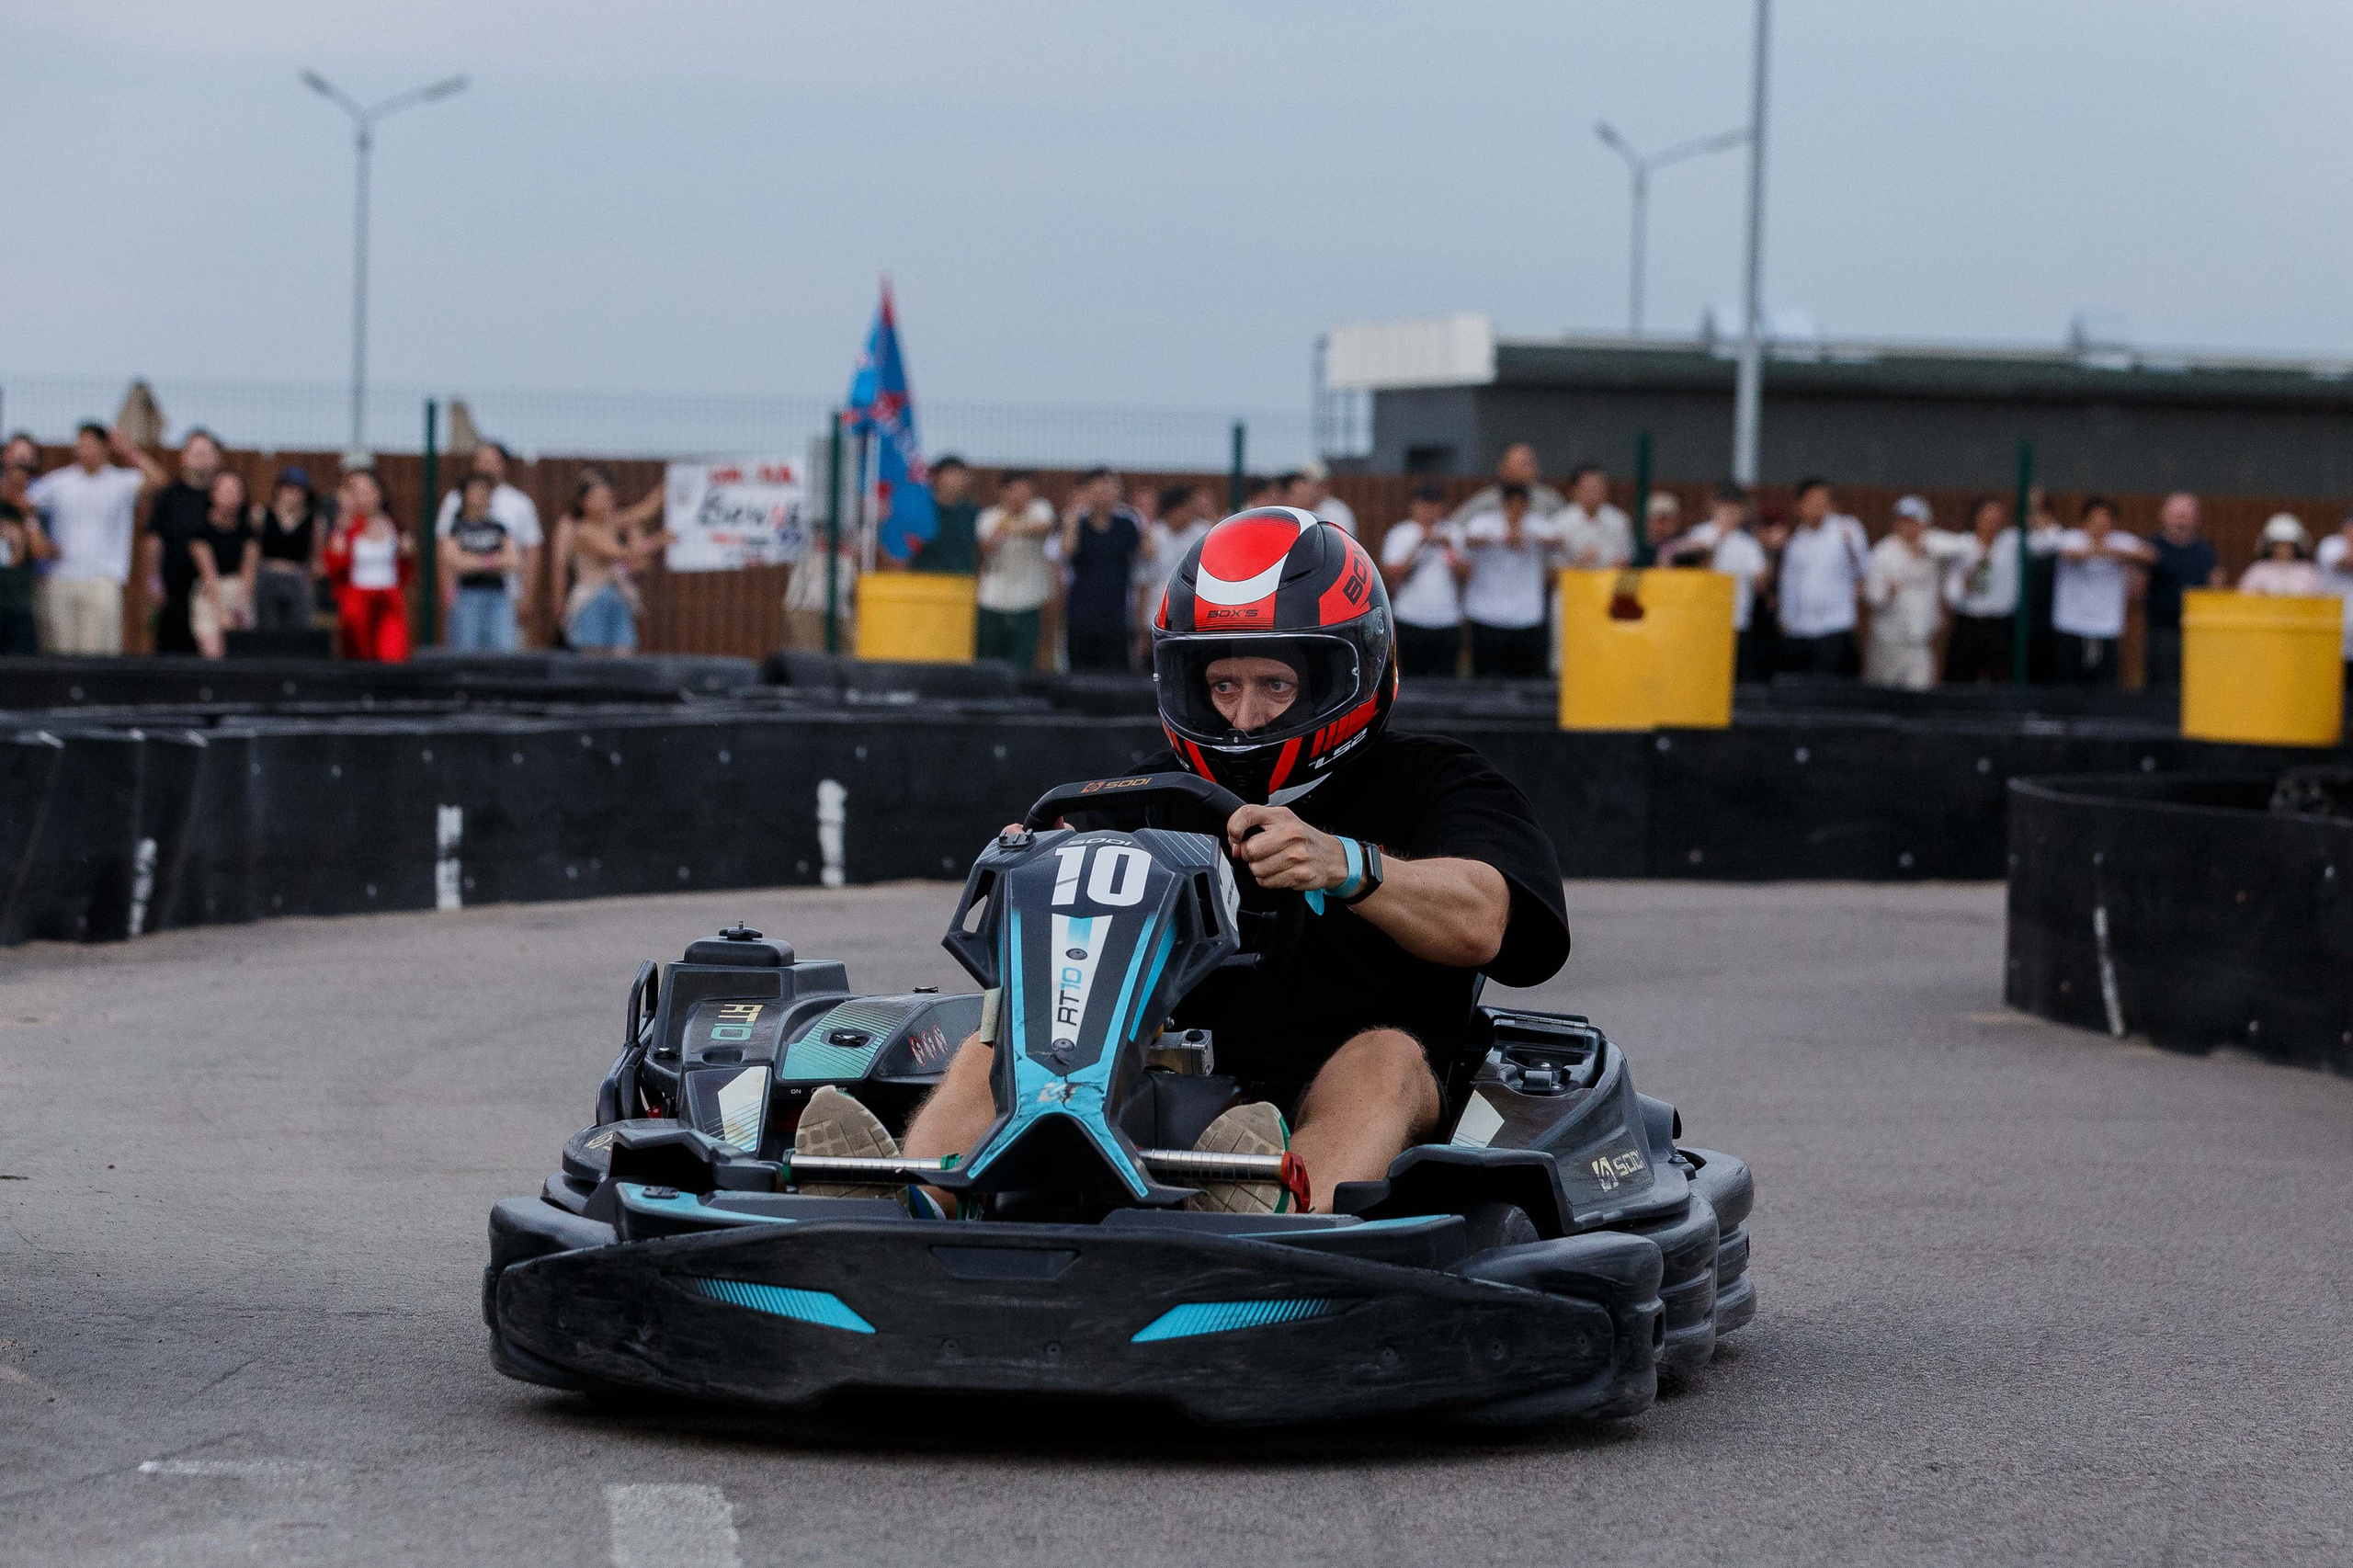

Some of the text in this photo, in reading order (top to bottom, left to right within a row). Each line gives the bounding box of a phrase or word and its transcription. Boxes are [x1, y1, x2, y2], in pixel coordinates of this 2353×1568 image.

[1207, 608, 1259, 619] BOX'S
[1314, 727, 1368, 769] LS2
[1103, 778, 1153, 790] SODI
[1068, 837, 1132, 846] SODI
[1051, 846, 1153, 906] 10
[1057, 966, 1083, 1027] RT10
[710, 1004, 764, 1040] RT10
